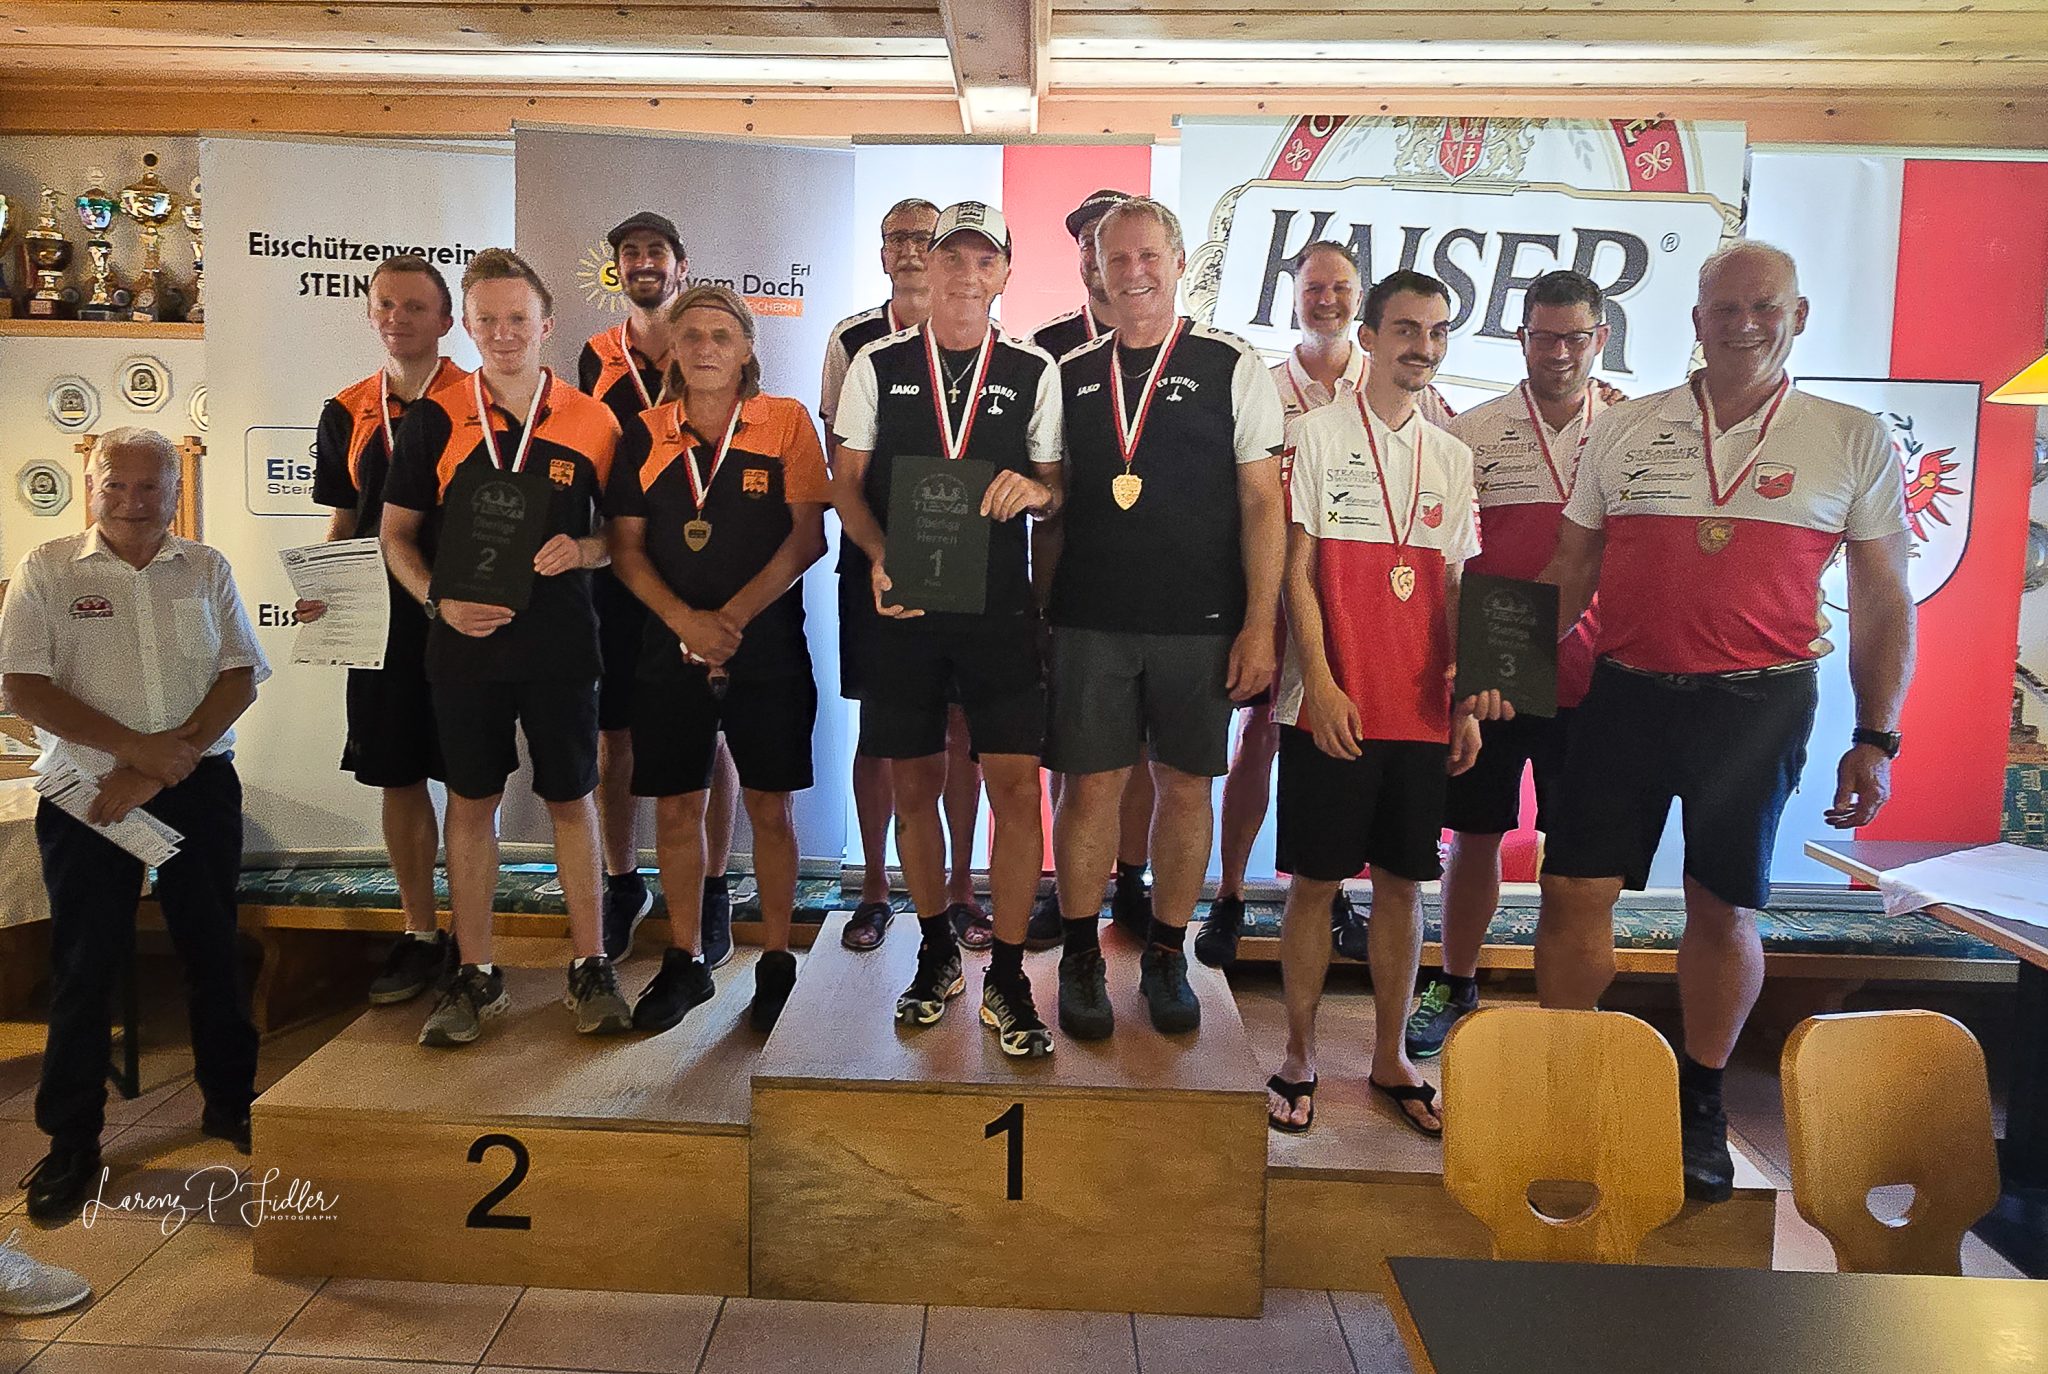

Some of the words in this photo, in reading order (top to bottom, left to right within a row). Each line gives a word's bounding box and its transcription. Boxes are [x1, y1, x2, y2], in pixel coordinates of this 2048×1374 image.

[248, 231, 476, 264] Eisschützenverein
[791, 263, 811, 276] Erl
[742, 274, 804, 297] Dach
[1248, 209, 1649, 374] KAISER
[889, 384, 920, 396] JAKO
[266, 458, 317, 481] Eis
[476, 547, 498, 571] 2
[929, 548, 943, 577] 1
[1499, 653, 1516, 677] 3
[984, 1103, 1024, 1201] 1
[465, 1133, 531, 1230] 2
